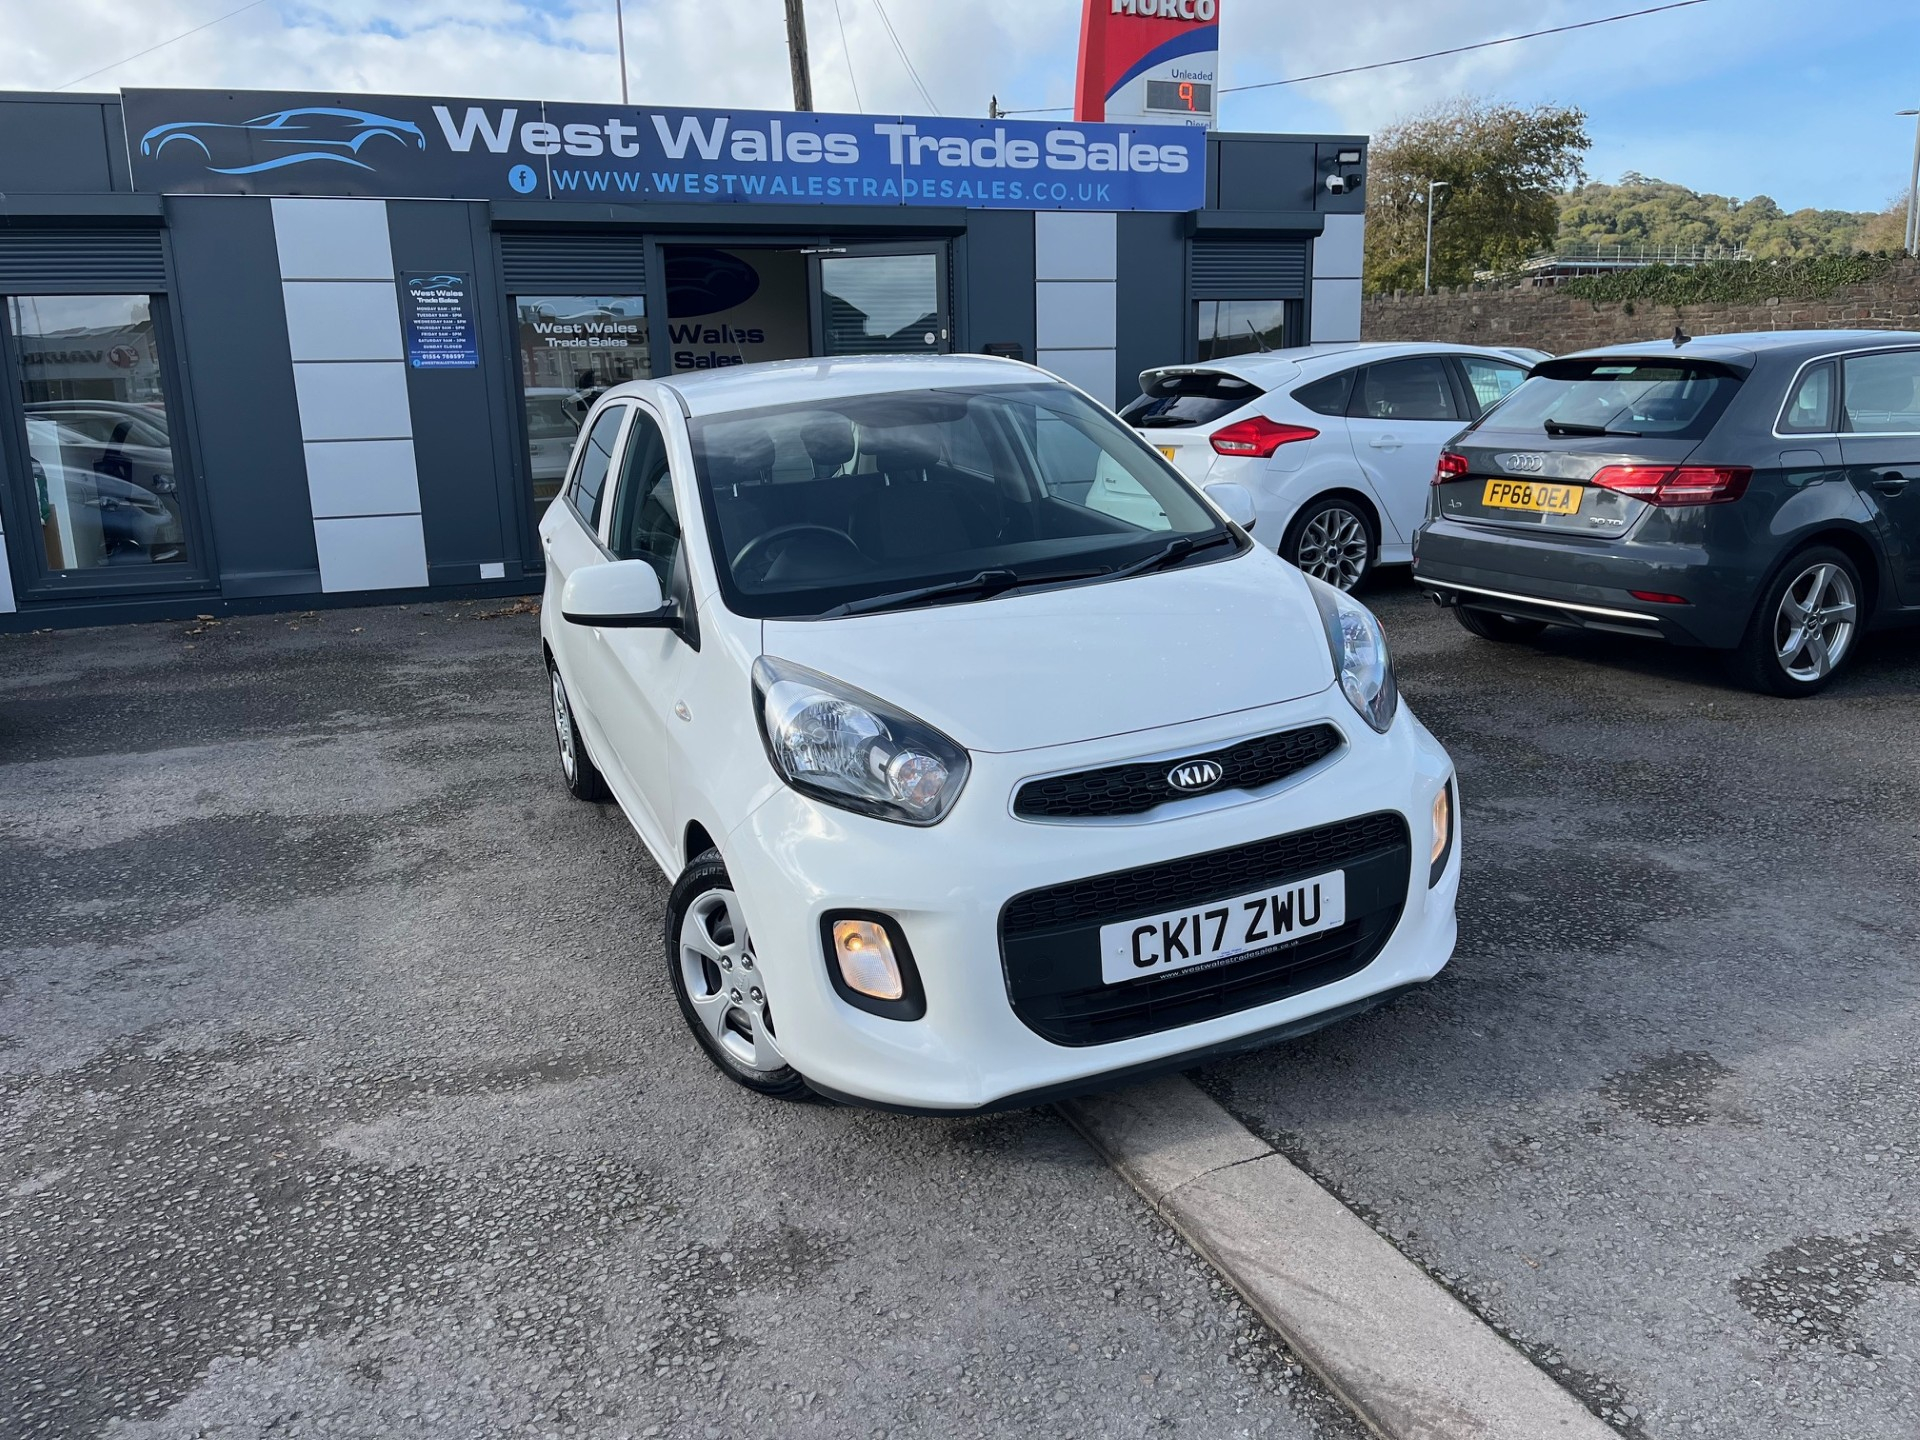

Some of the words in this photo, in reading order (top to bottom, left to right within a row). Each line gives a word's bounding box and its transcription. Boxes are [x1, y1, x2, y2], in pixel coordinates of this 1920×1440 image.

[1171, 68, 1213, 81] Unleaded
[432, 105, 640, 158] West
[650, 114, 860, 164] Wales
[874, 123, 1039, 169] Trade
[1045, 129, 1189, 173] Sales
[552, 169, 1110, 202] WWW.WESTWALESTRADESALES.CO.UK
[410, 289, 436, 297] West
[436, 289, 464, 297] Wales
[533, 322, 582, 334] West
[584, 322, 638, 334] Wales
[668, 324, 765, 345] Wales
[545, 337, 588, 348] Trade
[588, 337, 629, 348] Sales
[1489, 483, 1532, 505] FP68
[1536, 487, 1570, 508] OEA
[1176, 763, 1217, 786] KIA
[1131, 906, 1230, 968] CK17
[1244, 884, 1322, 943] ZWU
[1159, 940, 1300, 980] www.westwalestradesales.co.uk
